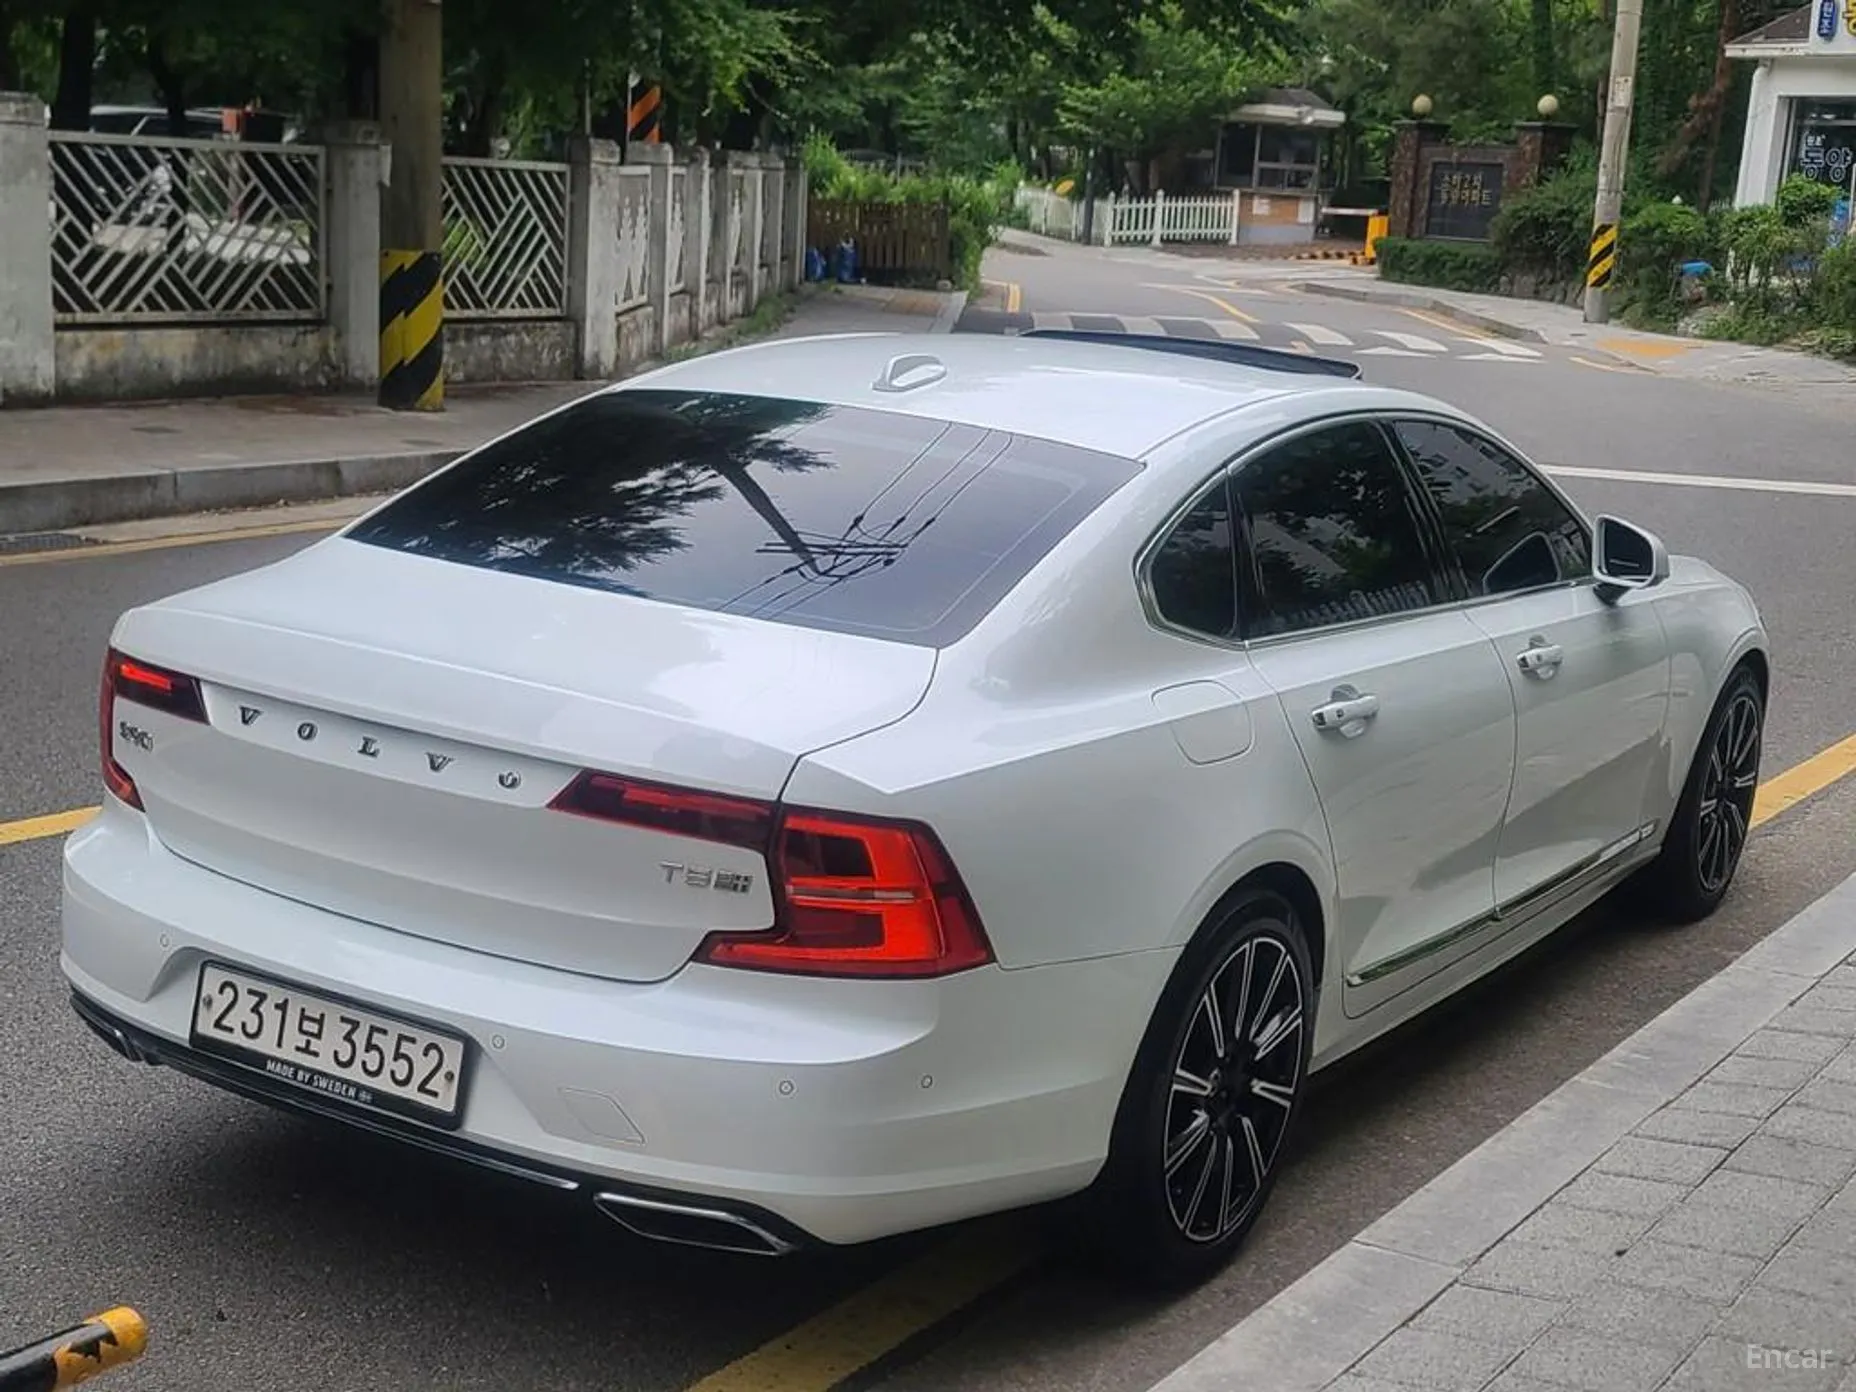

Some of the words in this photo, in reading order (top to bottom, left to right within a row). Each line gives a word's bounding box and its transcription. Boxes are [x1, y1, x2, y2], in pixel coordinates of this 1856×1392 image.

[239, 706, 522, 790] VOLVO
[266, 1059, 296, 1079] MADE
[296, 1069, 311, 1084] BY
[312, 1074, 357, 1099] SWEDEN
